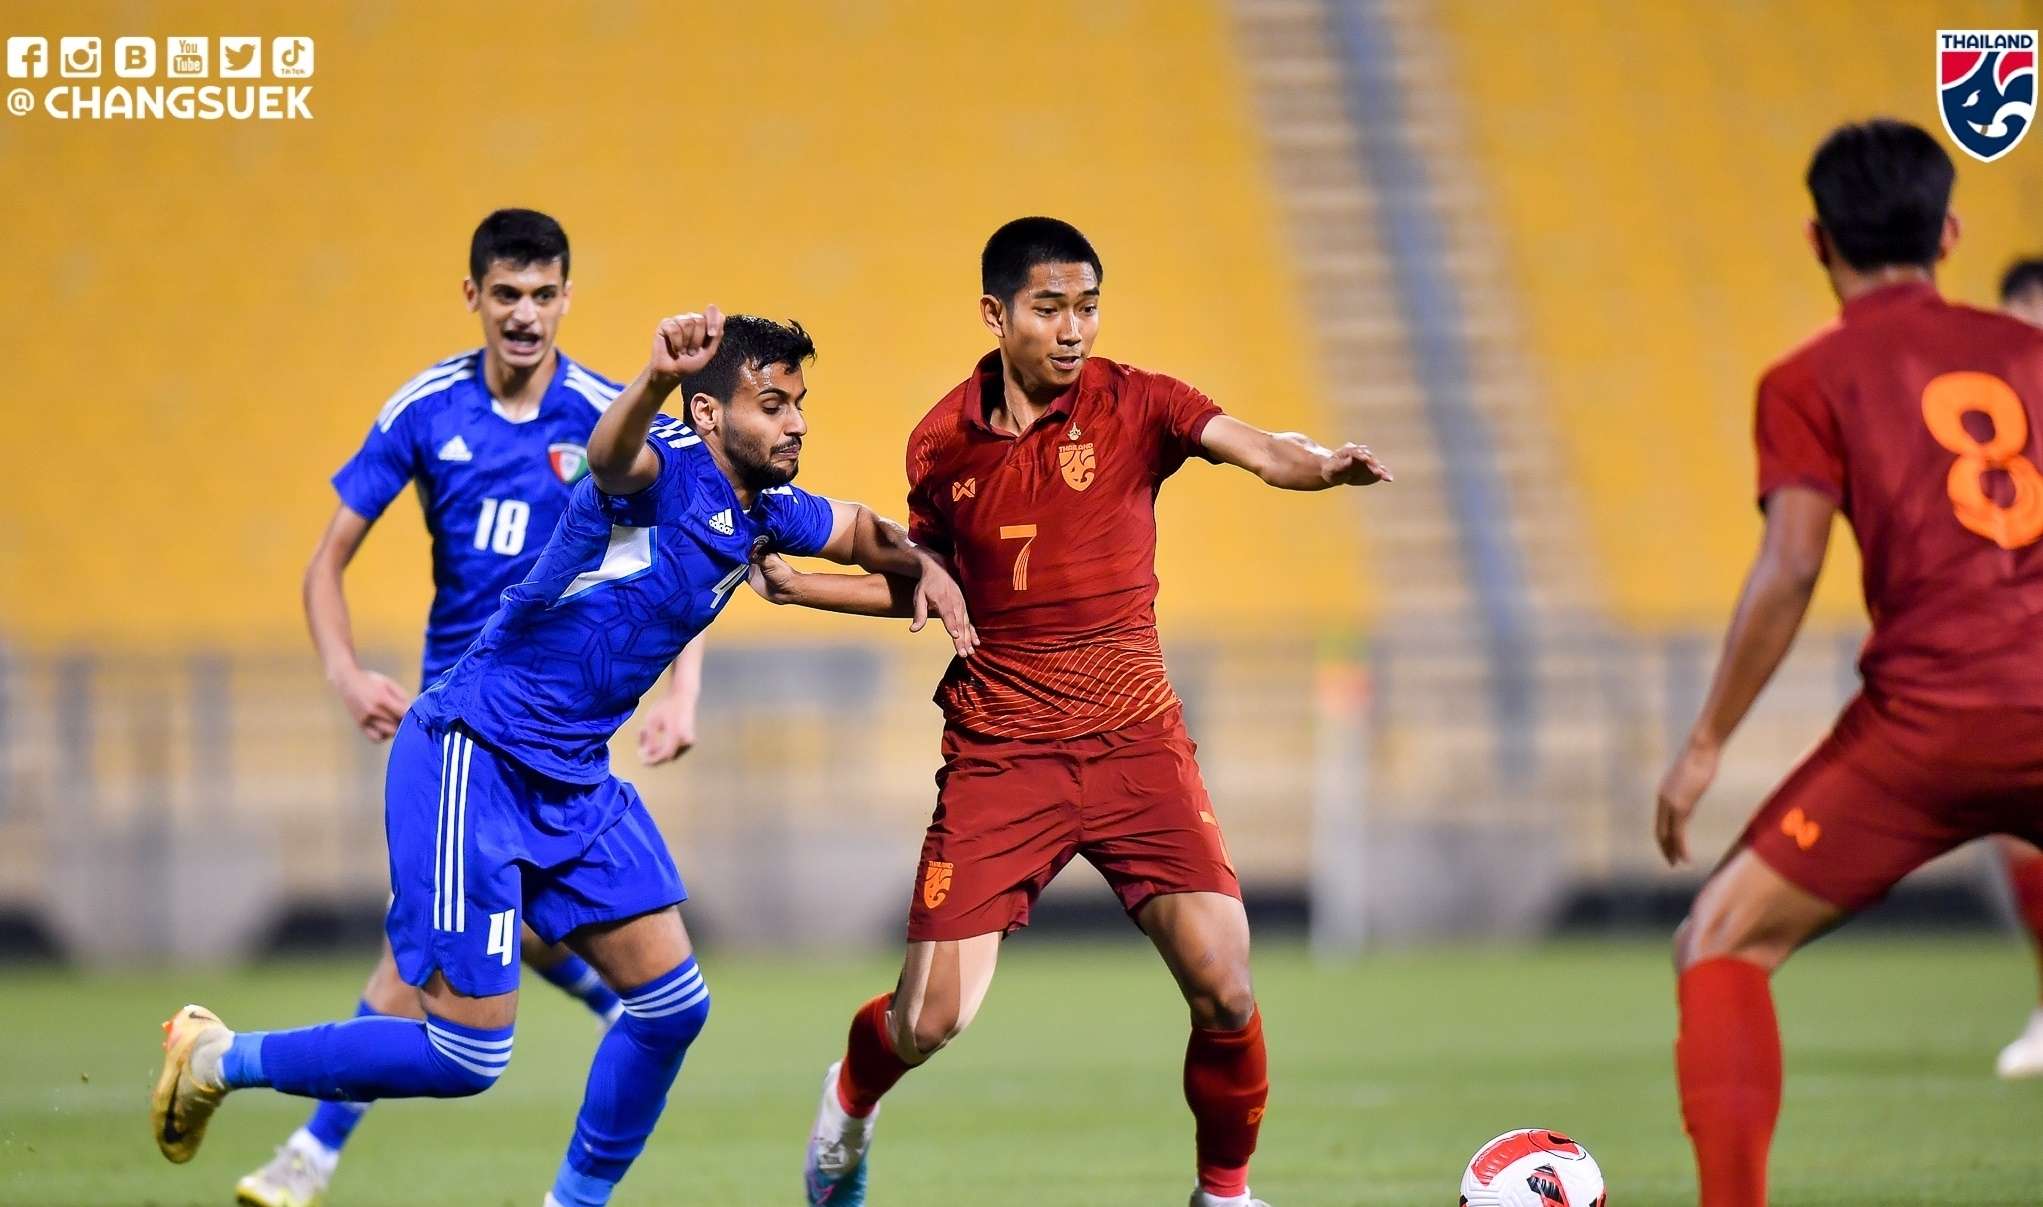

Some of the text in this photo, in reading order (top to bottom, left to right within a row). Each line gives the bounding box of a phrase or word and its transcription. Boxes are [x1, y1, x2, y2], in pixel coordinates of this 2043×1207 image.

[1921, 371, 2043, 550] 8
[473, 498, 530, 556] 18
[1000, 524, 1037, 591] 7
[486, 908, 516, 967] 4
